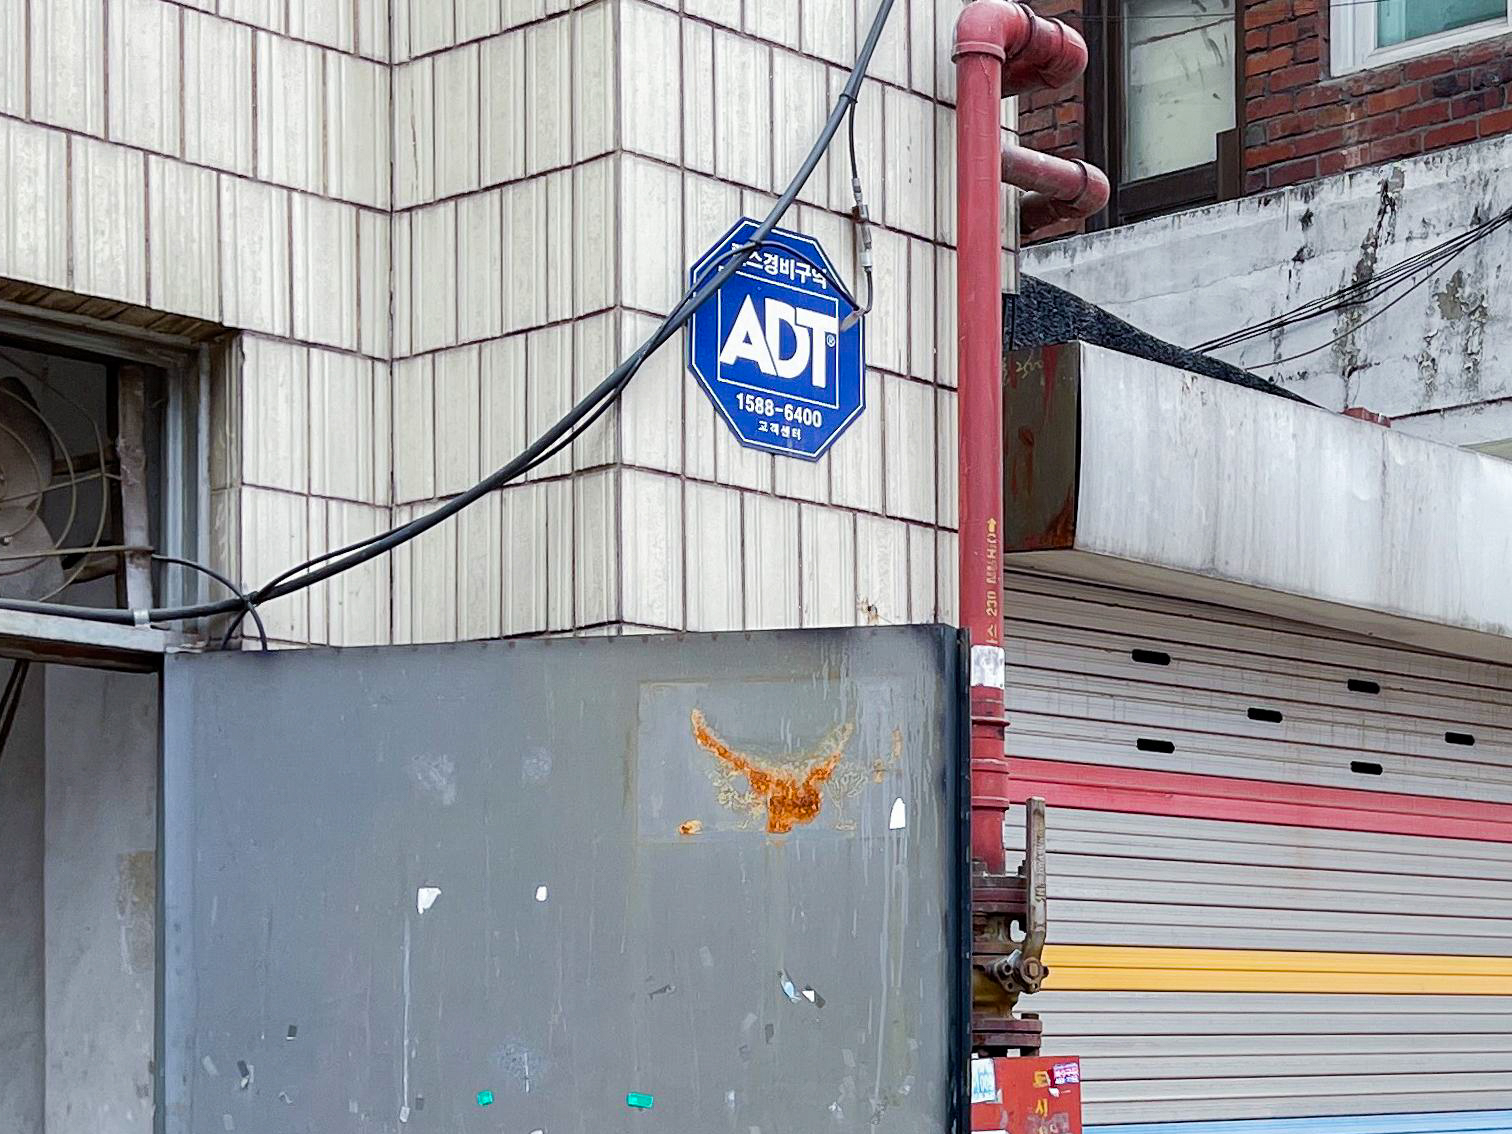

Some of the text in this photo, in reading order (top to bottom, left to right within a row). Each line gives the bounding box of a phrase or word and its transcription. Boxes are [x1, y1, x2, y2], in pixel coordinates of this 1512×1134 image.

[731, 242, 828, 290] 스경비구역
[719, 293, 838, 389] ADT
[735, 392, 823, 428] 1588-6400
[757, 420, 802, 441] 고객센터
